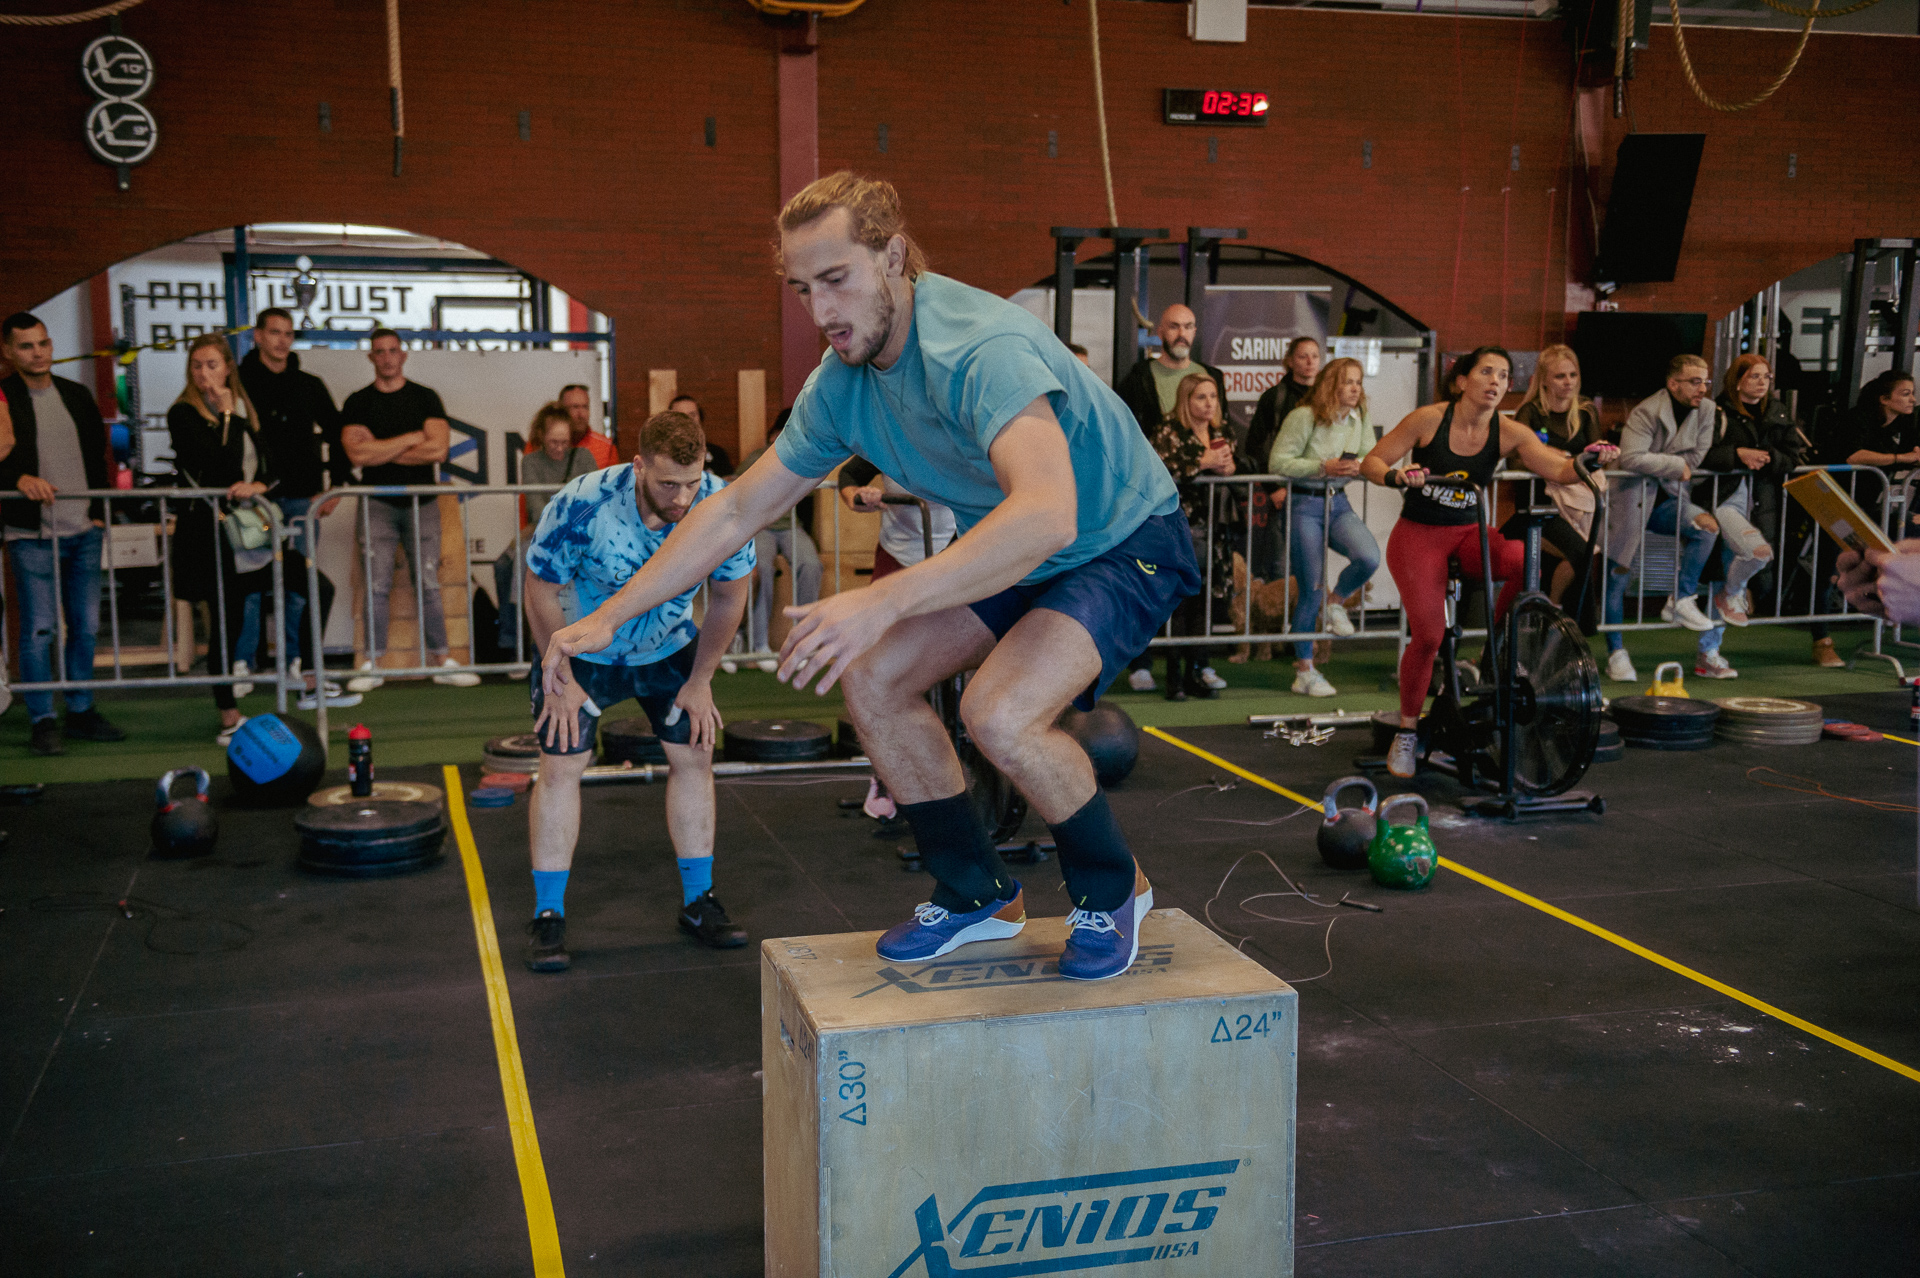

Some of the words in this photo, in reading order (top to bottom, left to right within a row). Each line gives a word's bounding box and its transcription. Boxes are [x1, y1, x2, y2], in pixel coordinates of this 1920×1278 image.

[149, 282, 218, 310] PAI
[320, 285, 413, 312] JUST
[887, 1160, 1240, 1278] XENIOS
[1151, 1241, 1200, 1261] USA
